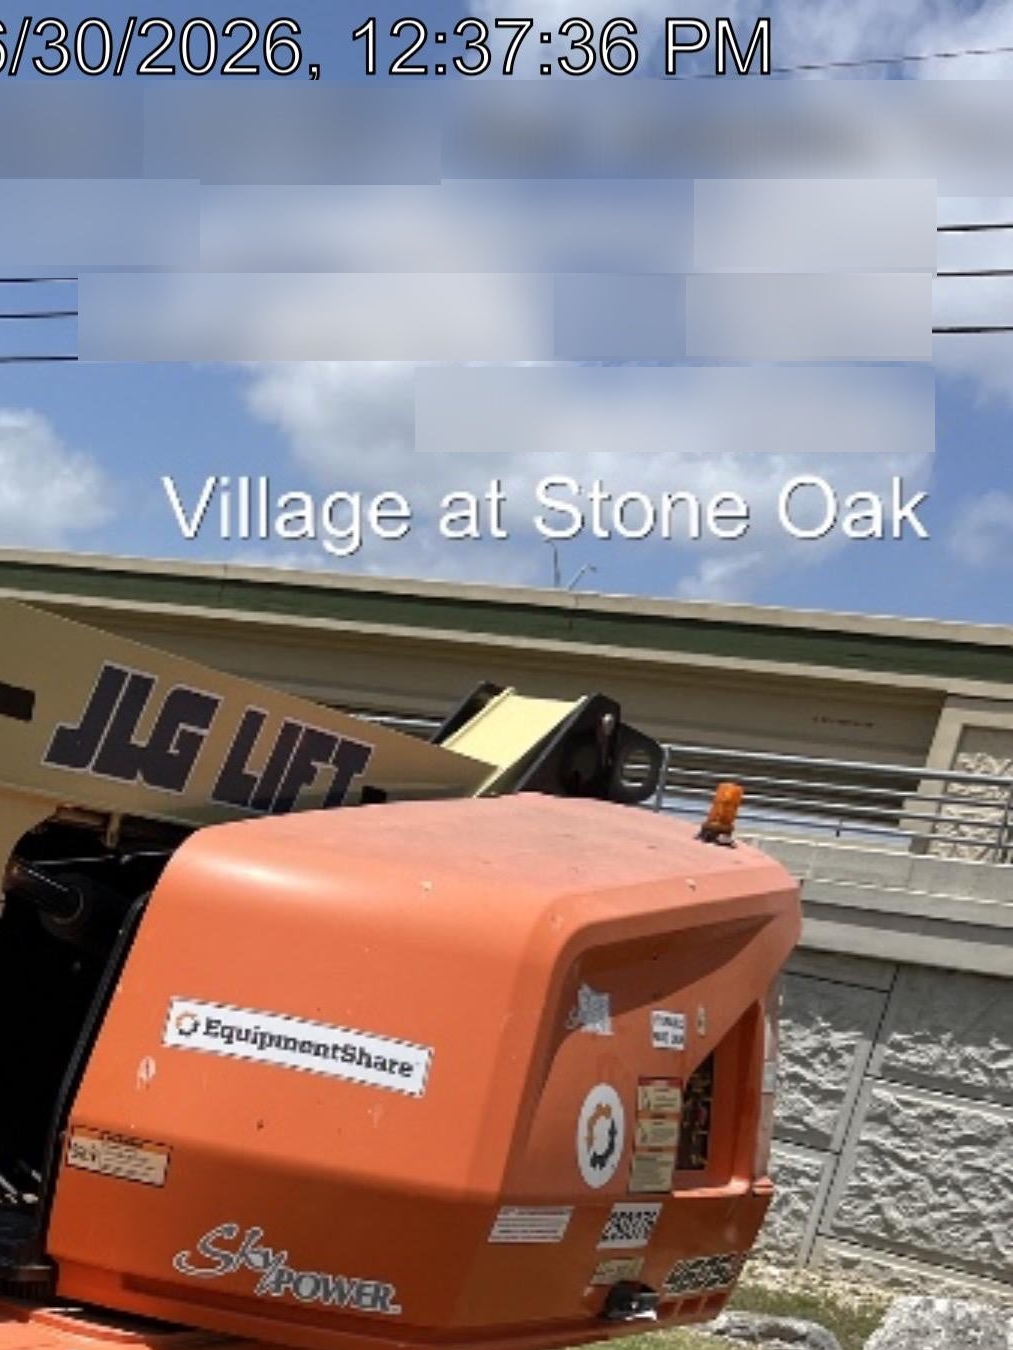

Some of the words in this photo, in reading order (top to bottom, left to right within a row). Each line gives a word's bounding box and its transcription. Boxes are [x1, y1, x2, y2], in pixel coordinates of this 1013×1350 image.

[41, 660, 224, 794] JLG
[209, 704, 376, 814] LIFT
[202, 1016, 414, 1077] EquipmentShare
[172, 1222, 288, 1296] Sky
[269, 1266, 398, 1315] POWER
